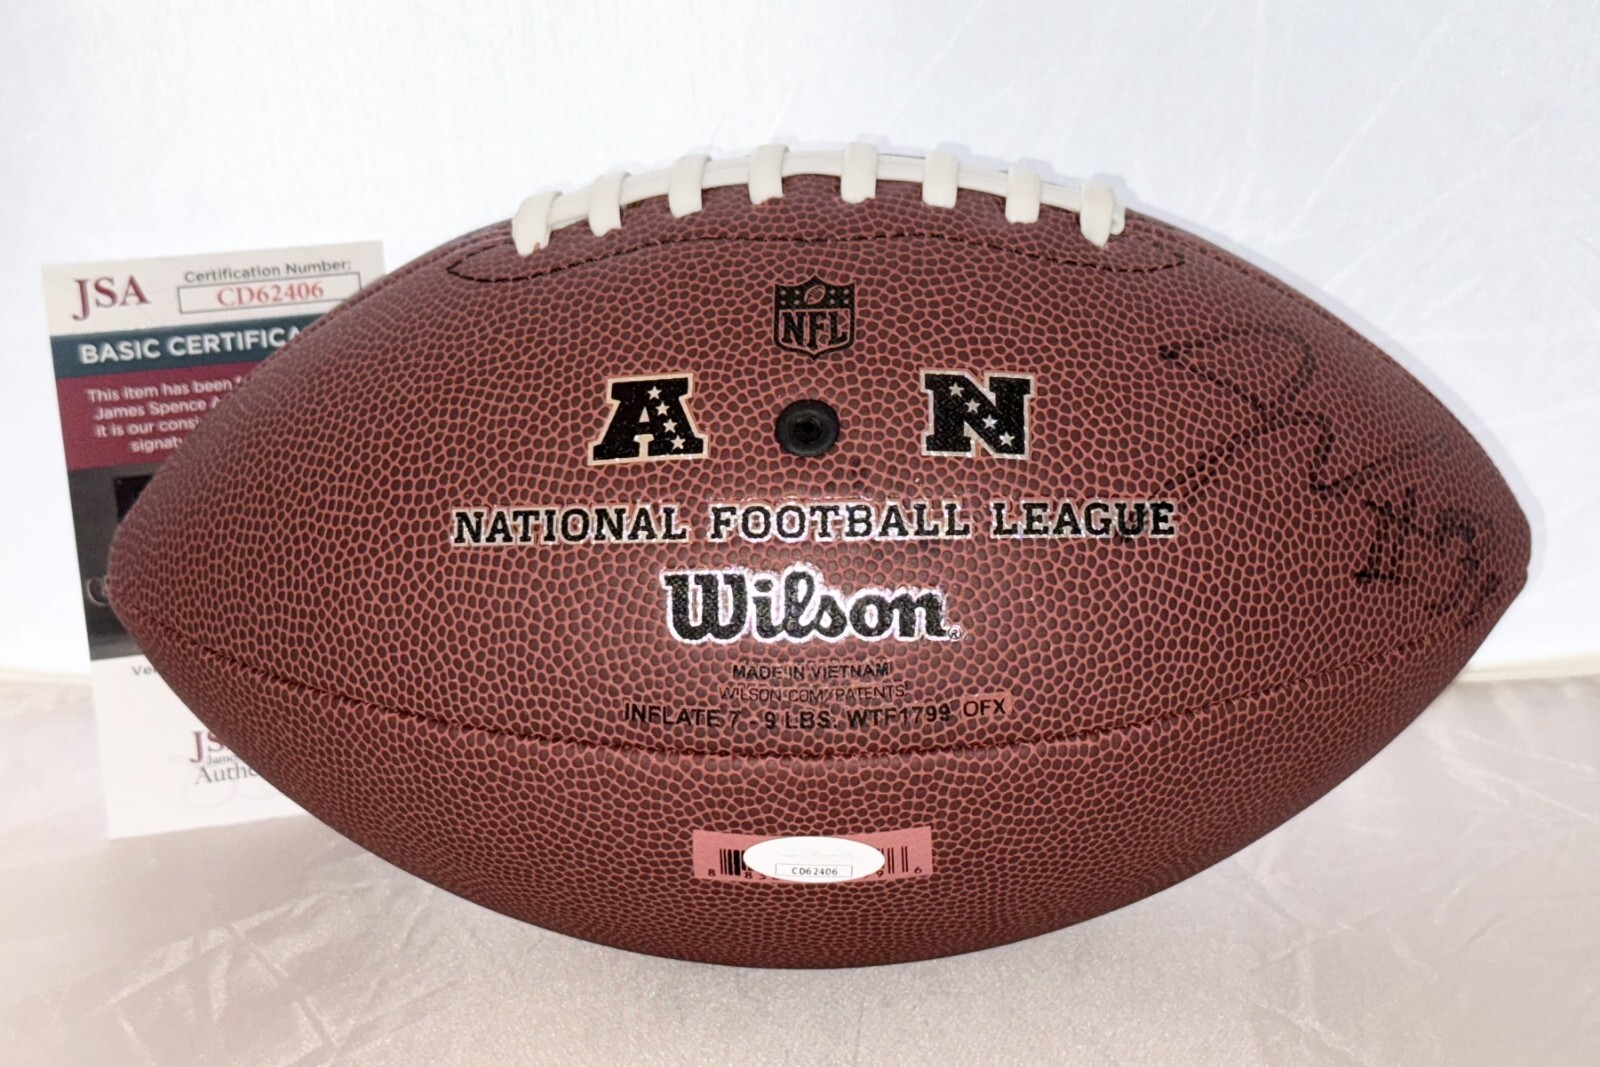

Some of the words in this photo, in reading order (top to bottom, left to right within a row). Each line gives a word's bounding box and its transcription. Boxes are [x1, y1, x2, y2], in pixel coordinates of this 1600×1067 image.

[184, 265, 281, 284] Certification
[285, 259, 351, 273] Number:
[71, 275, 151, 322] JSA
[217, 281, 324, 307] CD62406
[781, 311, 848, 349] NFL
[79, 338, 162, 365] BASIC
[87, 389, 120, 402] This
[122, 386, 159, 400] item
[161, 382, 190, 396] has
[191, 379, 233, 393] been
[95, 405, 146, 421] James
[148, 400, 207, 416] Spence
[586, 372, 709, 466] A
[919, 369, 1037, 461] N
[111, 423, 125, 436] is
[127, 421, 155, 435] our
[131, 436, 182, 452] signat
[452, 506, 690, 545] NATIONAL
[706, 500, 972, 545] FOOTBALL
[992, 500, 1180, 540] LEAGUE
[732, 663, 783, 680] MADE
[786, 664, 805, 679] IN
[810, 661, 893, 679] VIETNAM
[624, 702, 723, 727] INFLATE
[728, 709, 742, 728] 7
[766, 711, 777, 730] 9
[785, 708, 838, 729] LBS.
[848, 705, 953, 728] WTF1799
[962, 698, 1006, 718] OFX
[791, 867, 838, 876] CD62406
